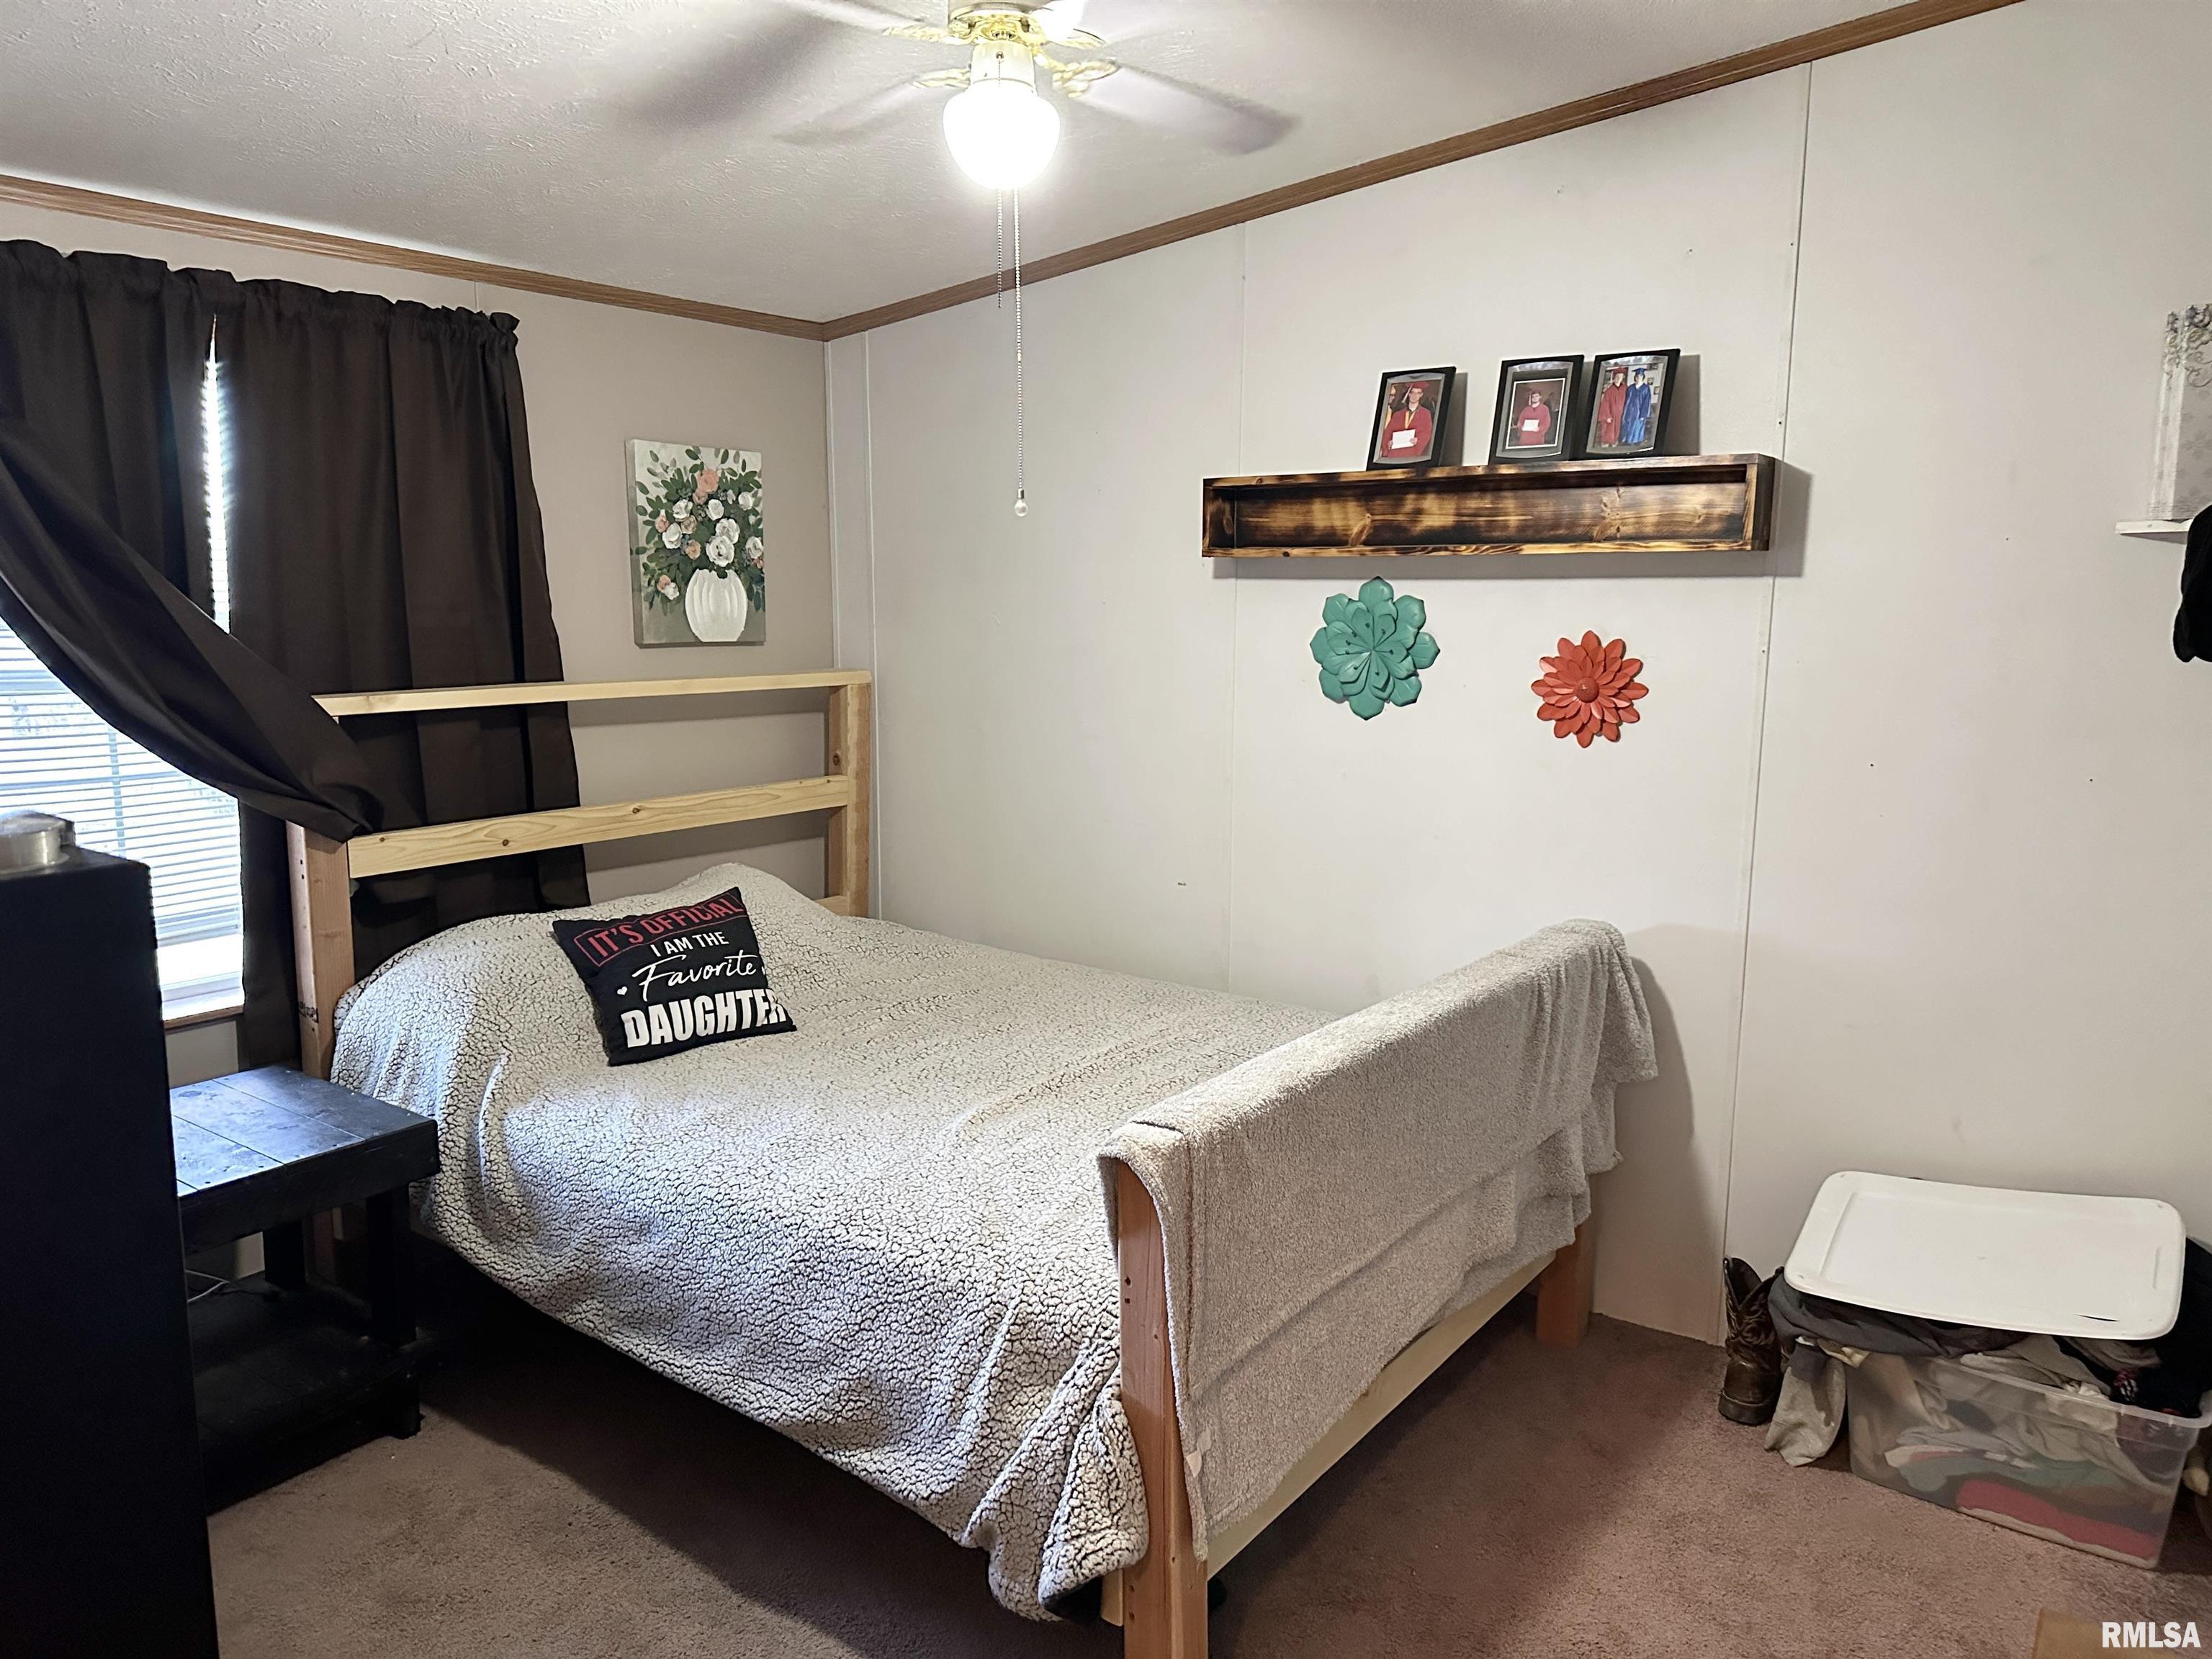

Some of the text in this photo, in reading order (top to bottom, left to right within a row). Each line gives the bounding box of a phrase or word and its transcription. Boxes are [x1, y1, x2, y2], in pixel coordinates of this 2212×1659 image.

[588, 897, 745, 958] IT'S OFFICIAL
[650, 931, 729, 957] I AM THE
[631, 949, 758, 1002] Favorite
[621, 988, 786, 1048] DAUGHTER
